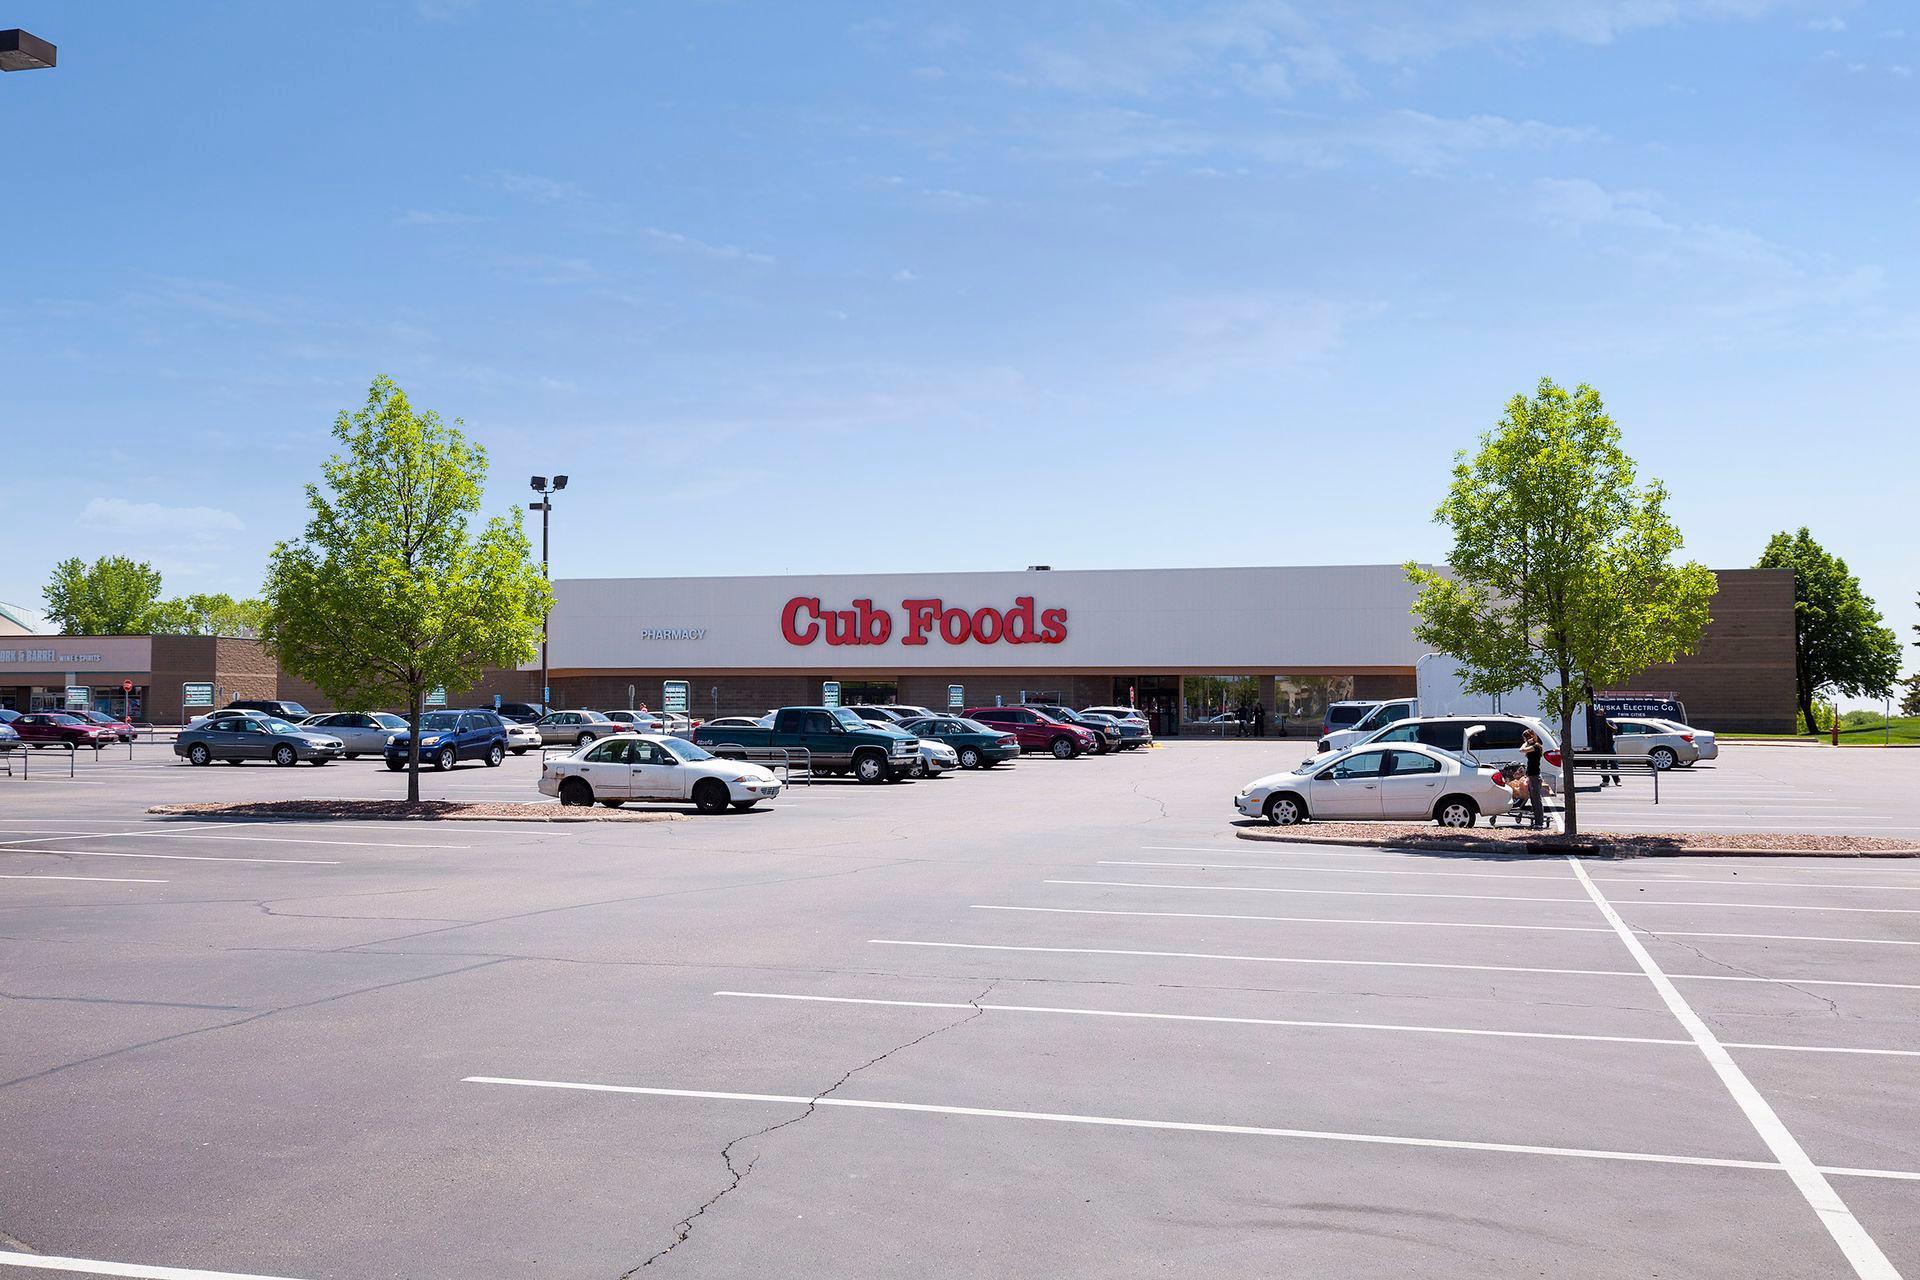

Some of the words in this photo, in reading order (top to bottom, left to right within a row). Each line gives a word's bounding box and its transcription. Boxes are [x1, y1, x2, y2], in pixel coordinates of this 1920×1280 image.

[781, 597, 892, 646] Cub
[902, 596, 1068, 646] Foods
[640, 629, 706, 640] PHARMACY
[26, 649, 56, 662] BARREL
